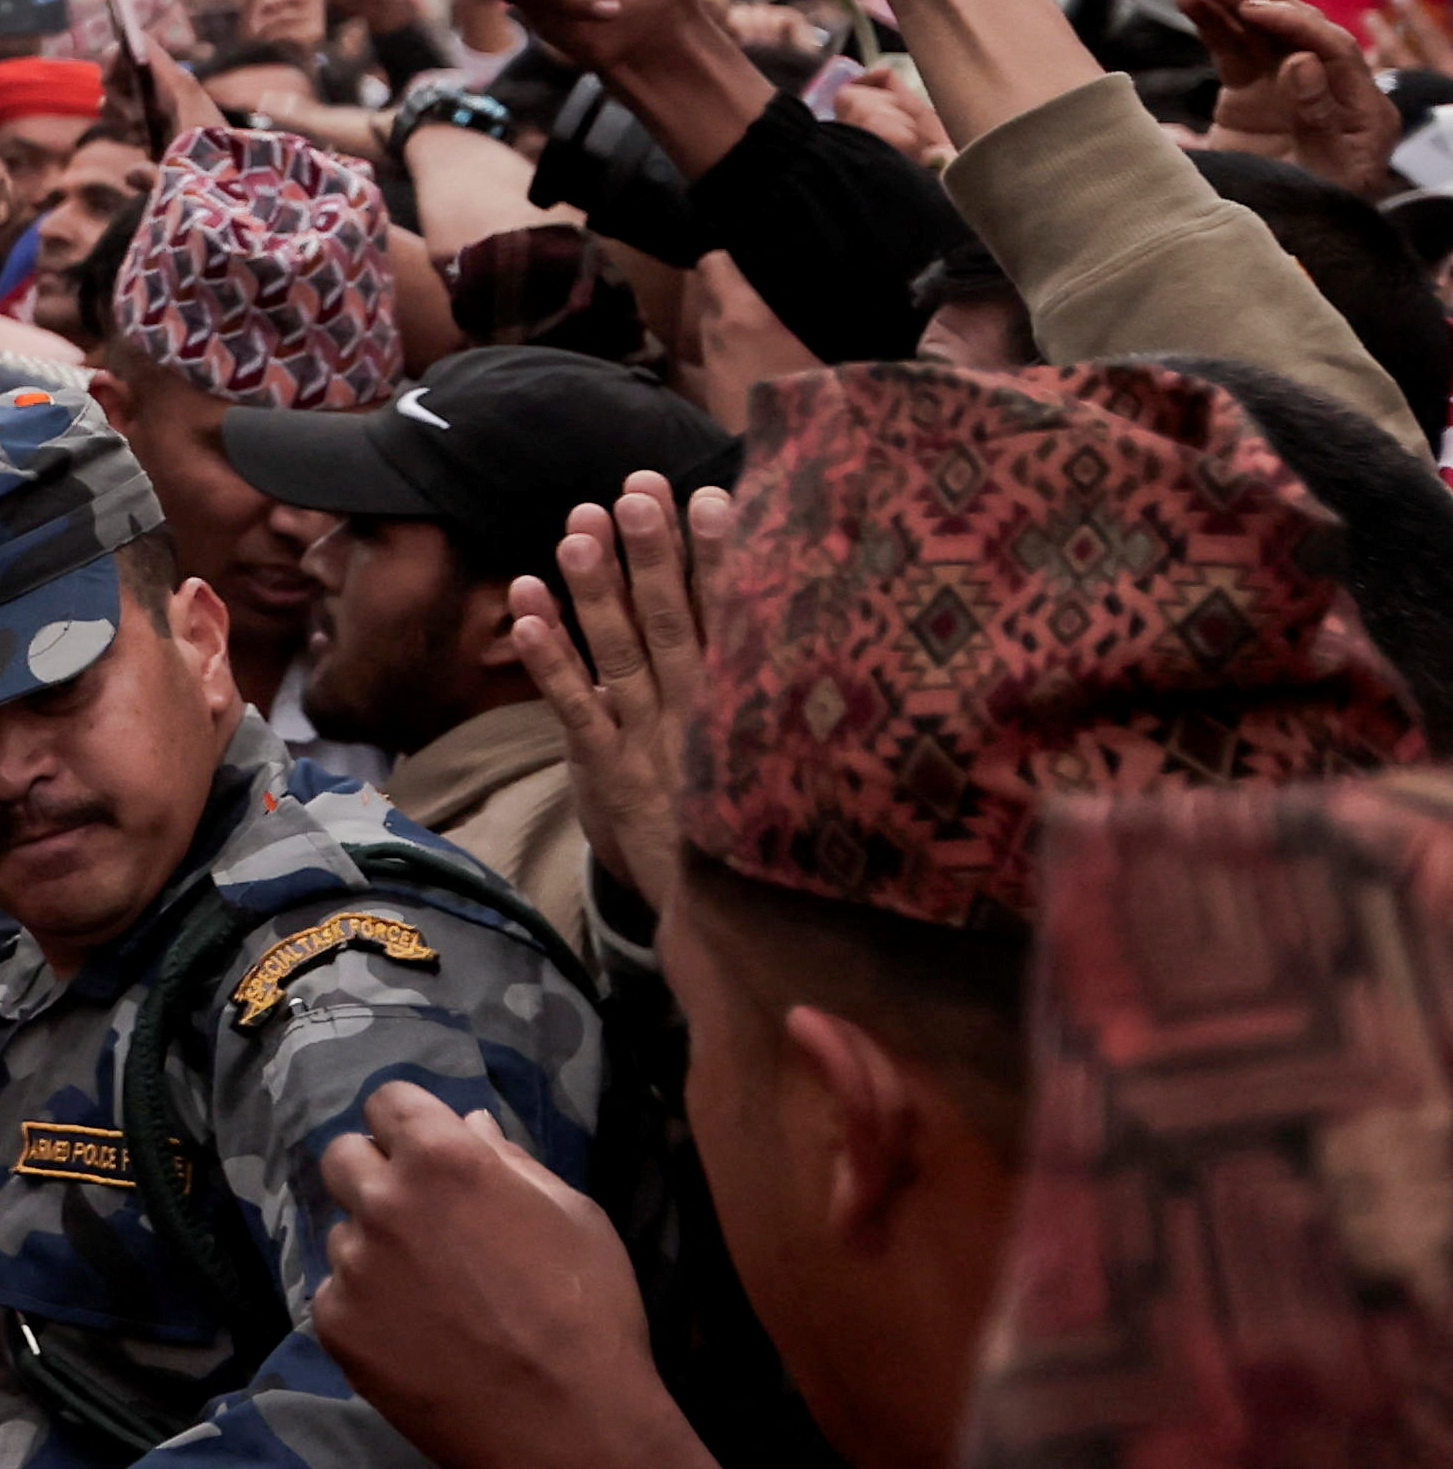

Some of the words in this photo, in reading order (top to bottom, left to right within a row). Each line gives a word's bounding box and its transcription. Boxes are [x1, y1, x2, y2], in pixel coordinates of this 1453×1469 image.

[244, 943, 303, 999] SPECIAL
[296, 919, 345, 952] TASK
[348, 917, 411, 947] FORCE
[28, 1138, 71, 1162] ARMED
[71, 1141, 118, 1170] POLICE
